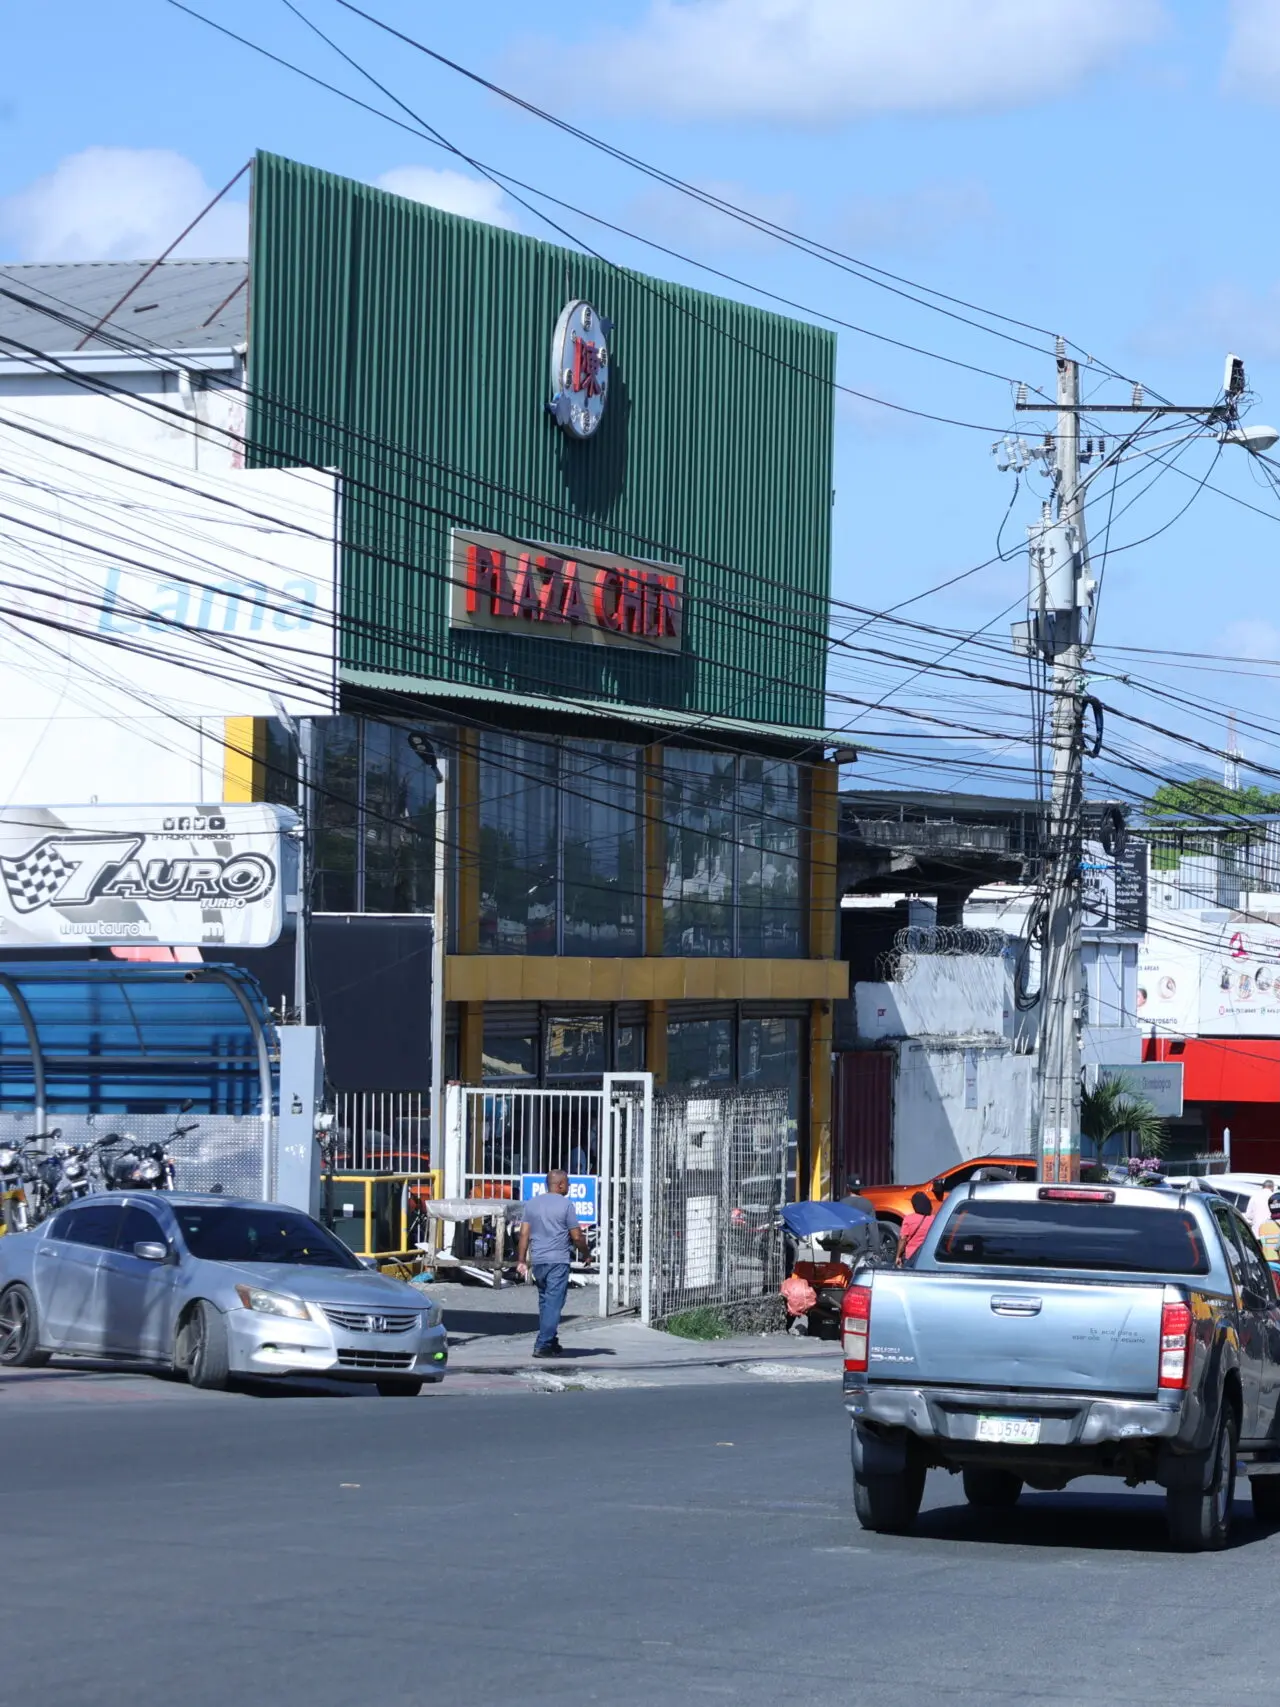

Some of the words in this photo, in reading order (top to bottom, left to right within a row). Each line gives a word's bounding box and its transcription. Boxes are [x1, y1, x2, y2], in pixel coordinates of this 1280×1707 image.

[97, 567, 317, 633] Lama
[466, 546, 582, 624] PLAZA
[594, 566, 677, 638] CHEN
[50, 835, 275, 904] TAURO
[200, 898, 247, 909] TURBO
[532, 1183, 586, 1198] PAEO
[872, 1346, 900, 1354] ISUZU
